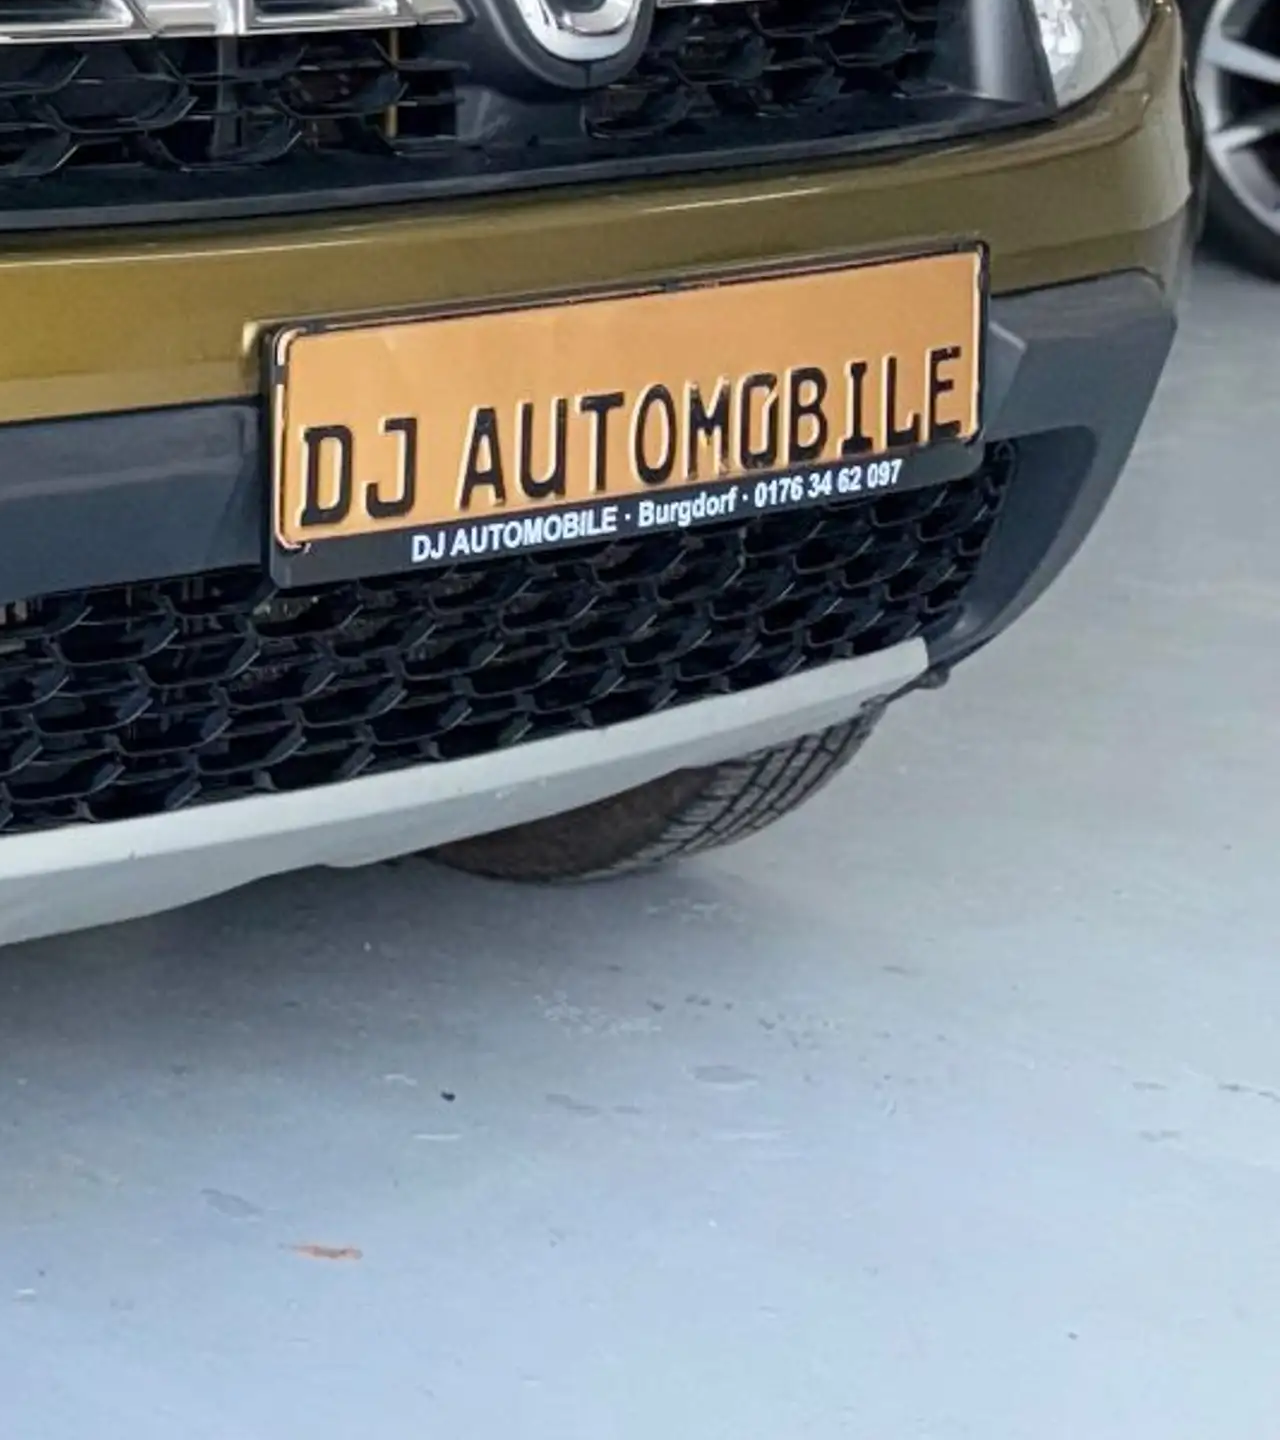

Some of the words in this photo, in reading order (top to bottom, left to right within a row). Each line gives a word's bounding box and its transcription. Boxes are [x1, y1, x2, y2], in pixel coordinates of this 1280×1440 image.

[298, 417, 418, 528] DJ
[454, 344, 962, 511] AUTOMOBILE
[411, 528, 446, 563] DJ
[449, 506, 618, 557] AUTOMOBILE
[638, 484, 739, 528] Burgdorf
[753, 474, 803, 508] 0176
[807, 471, 833, 499] 34
[837, 465, 862, 494] 62
[867, 458, 903, 489] 097
